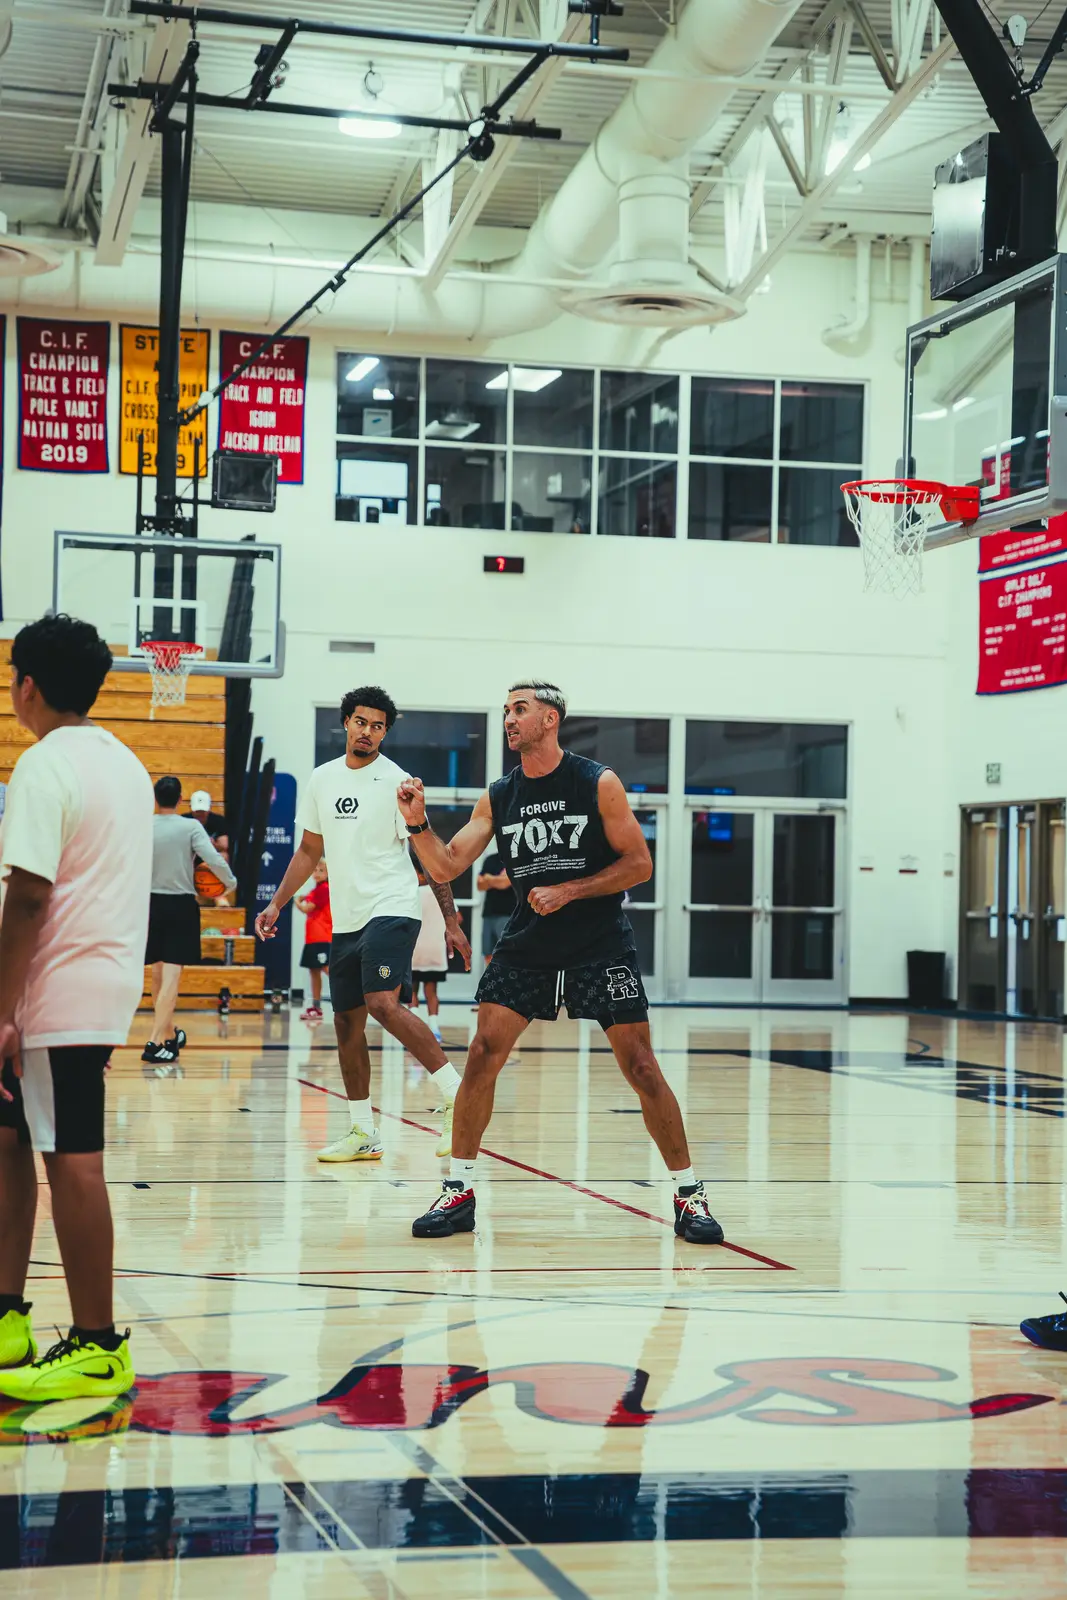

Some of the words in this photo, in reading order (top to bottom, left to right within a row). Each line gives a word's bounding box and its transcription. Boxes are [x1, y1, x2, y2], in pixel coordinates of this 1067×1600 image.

[29, 353, 99, 373] CHAMPION
[24, 374, 57, 394] TRACK
[76, 377, 105, 395] FIELD
[256, 386, 274, 405] AND
[279, 388, 304, 406] FIELD
[30, 398, 58, 417] POLE
[65, 400, 99, 418] VAULT
[124, 403, 155, 420] CROSS
[23, 419, 69, 440] NATHAN
[76, 423, 104, 441] SOTO
[222, 431, 260, 452] JACKSON
[40, 444, 88, 463] 2019
[520, 800, 566, 818] FORGIVE
